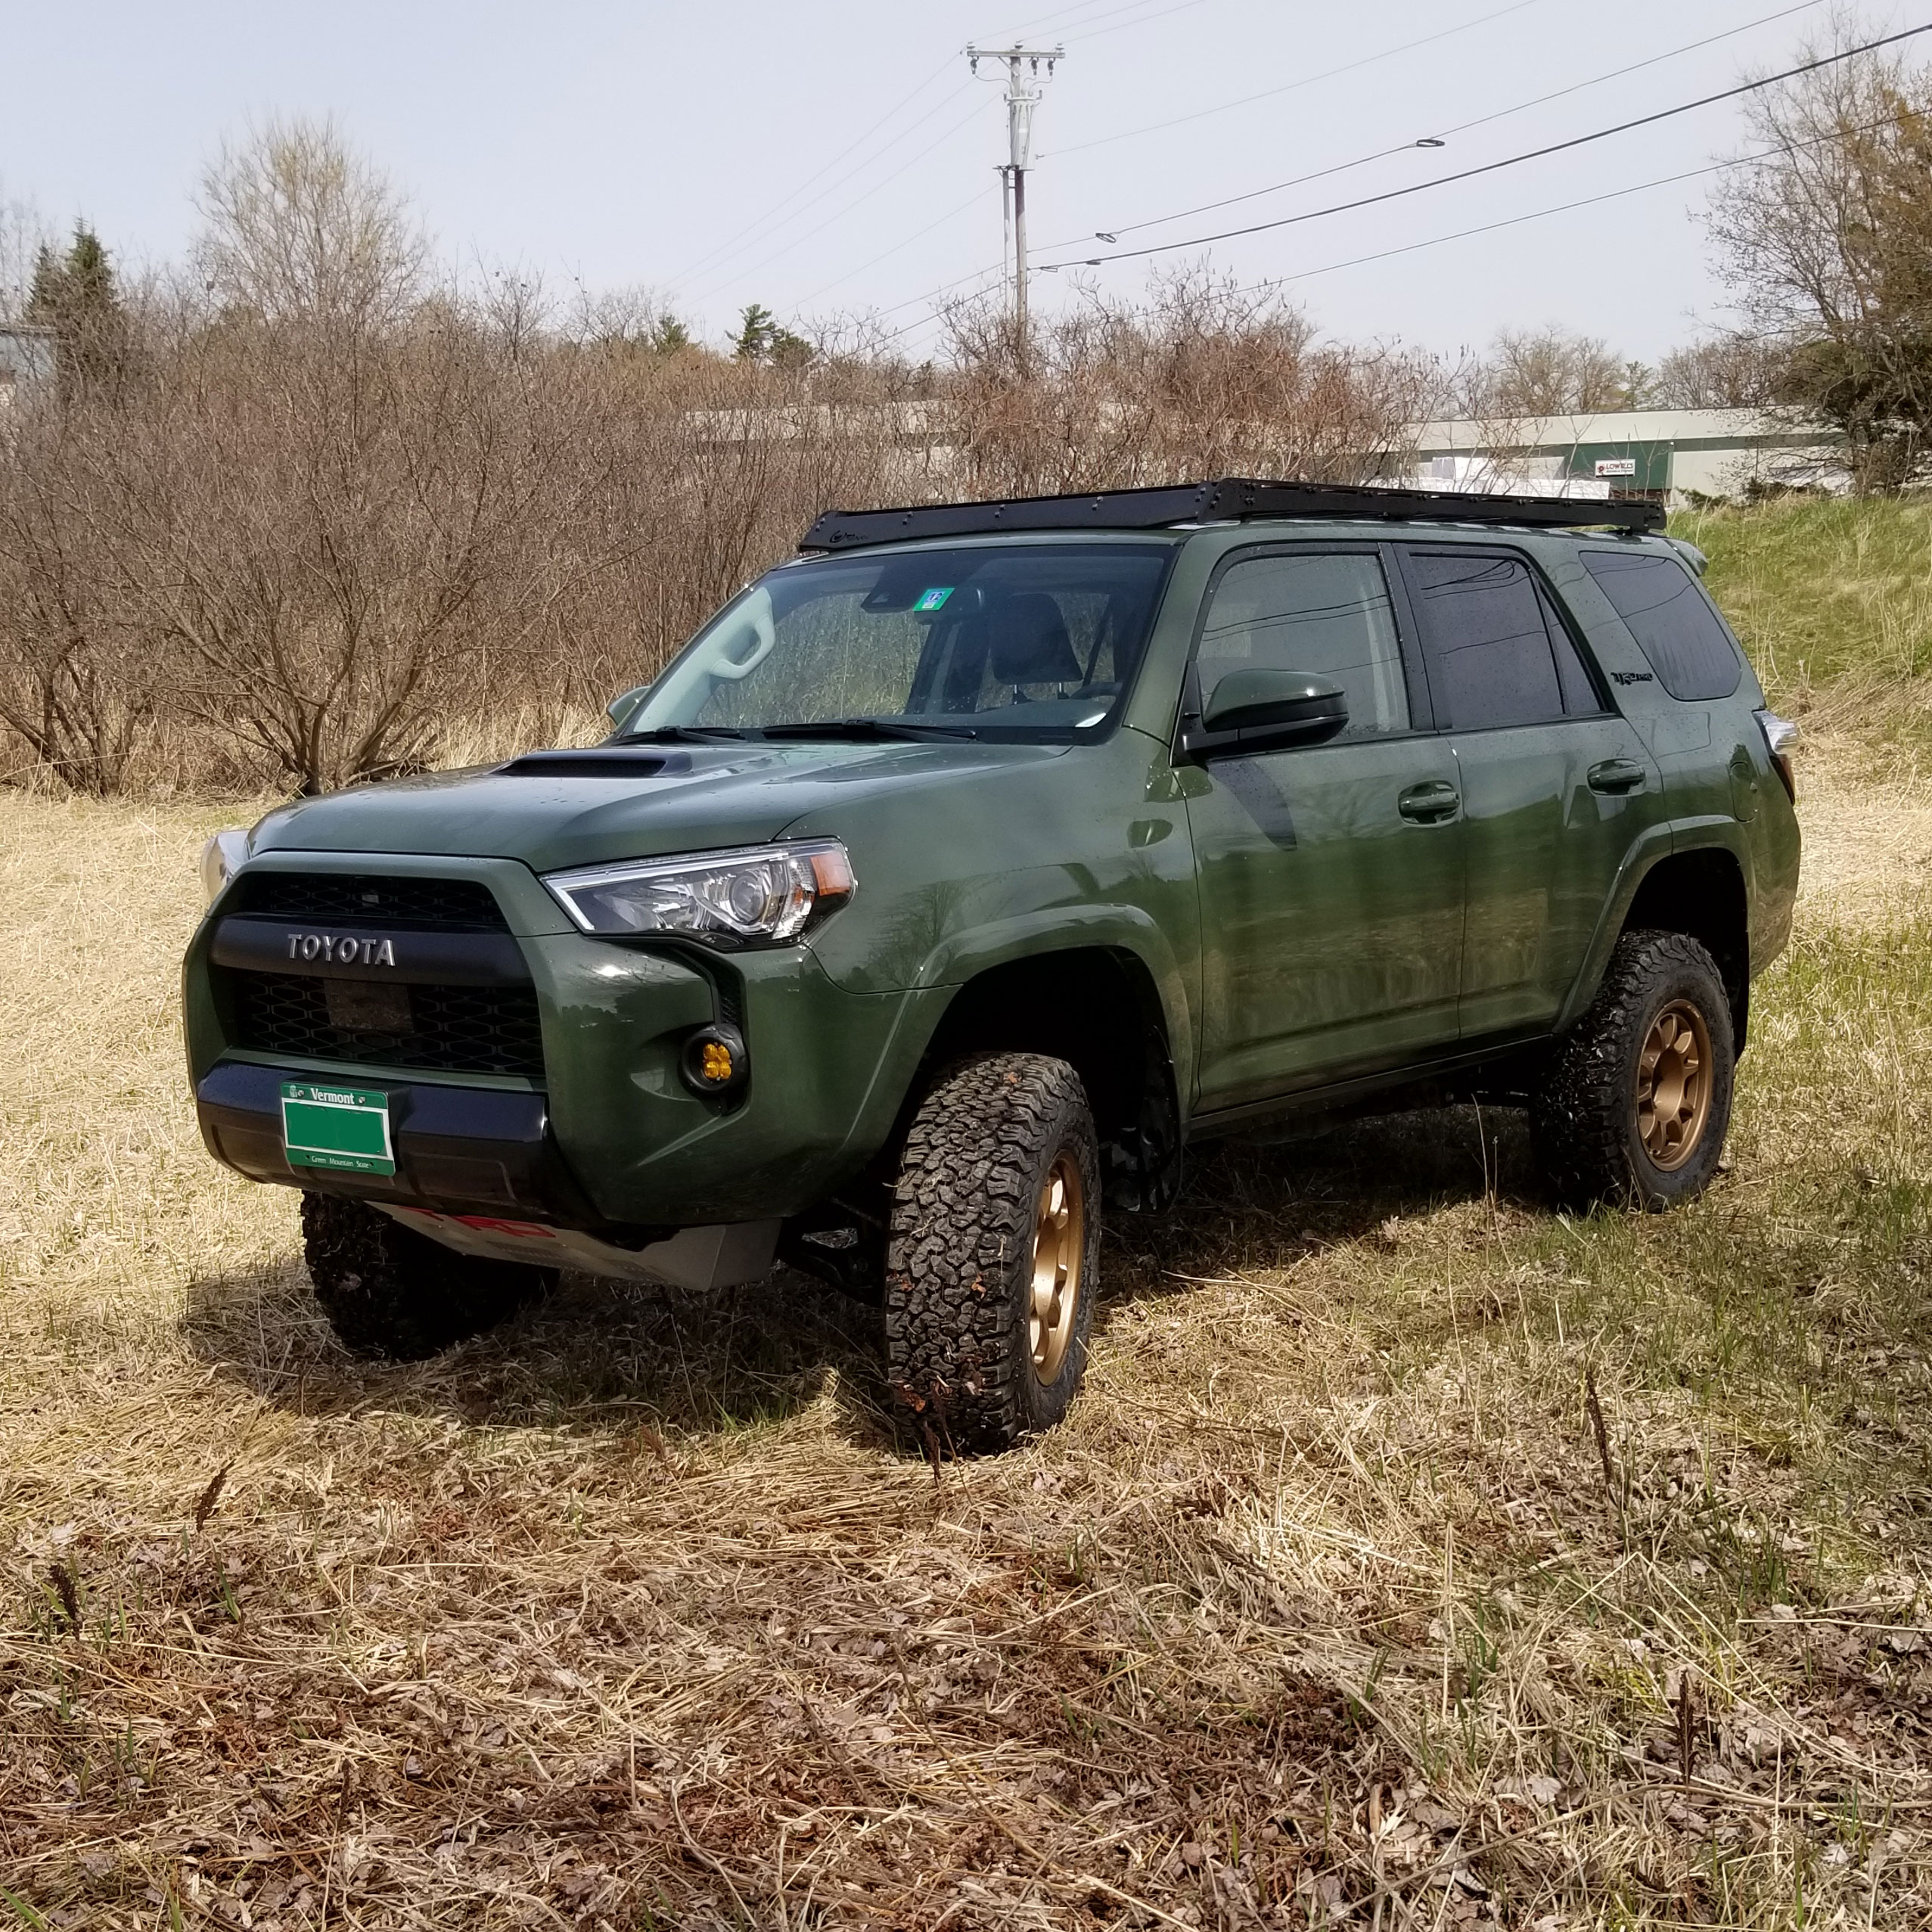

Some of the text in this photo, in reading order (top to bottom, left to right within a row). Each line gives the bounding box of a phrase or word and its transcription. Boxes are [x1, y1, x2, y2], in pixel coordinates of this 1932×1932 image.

[287, 933, 396, 966] TOYOTA
[310, 1087, 355, 1104] Vermont
[311, 1155, 369, 1169] Green Mountain State
